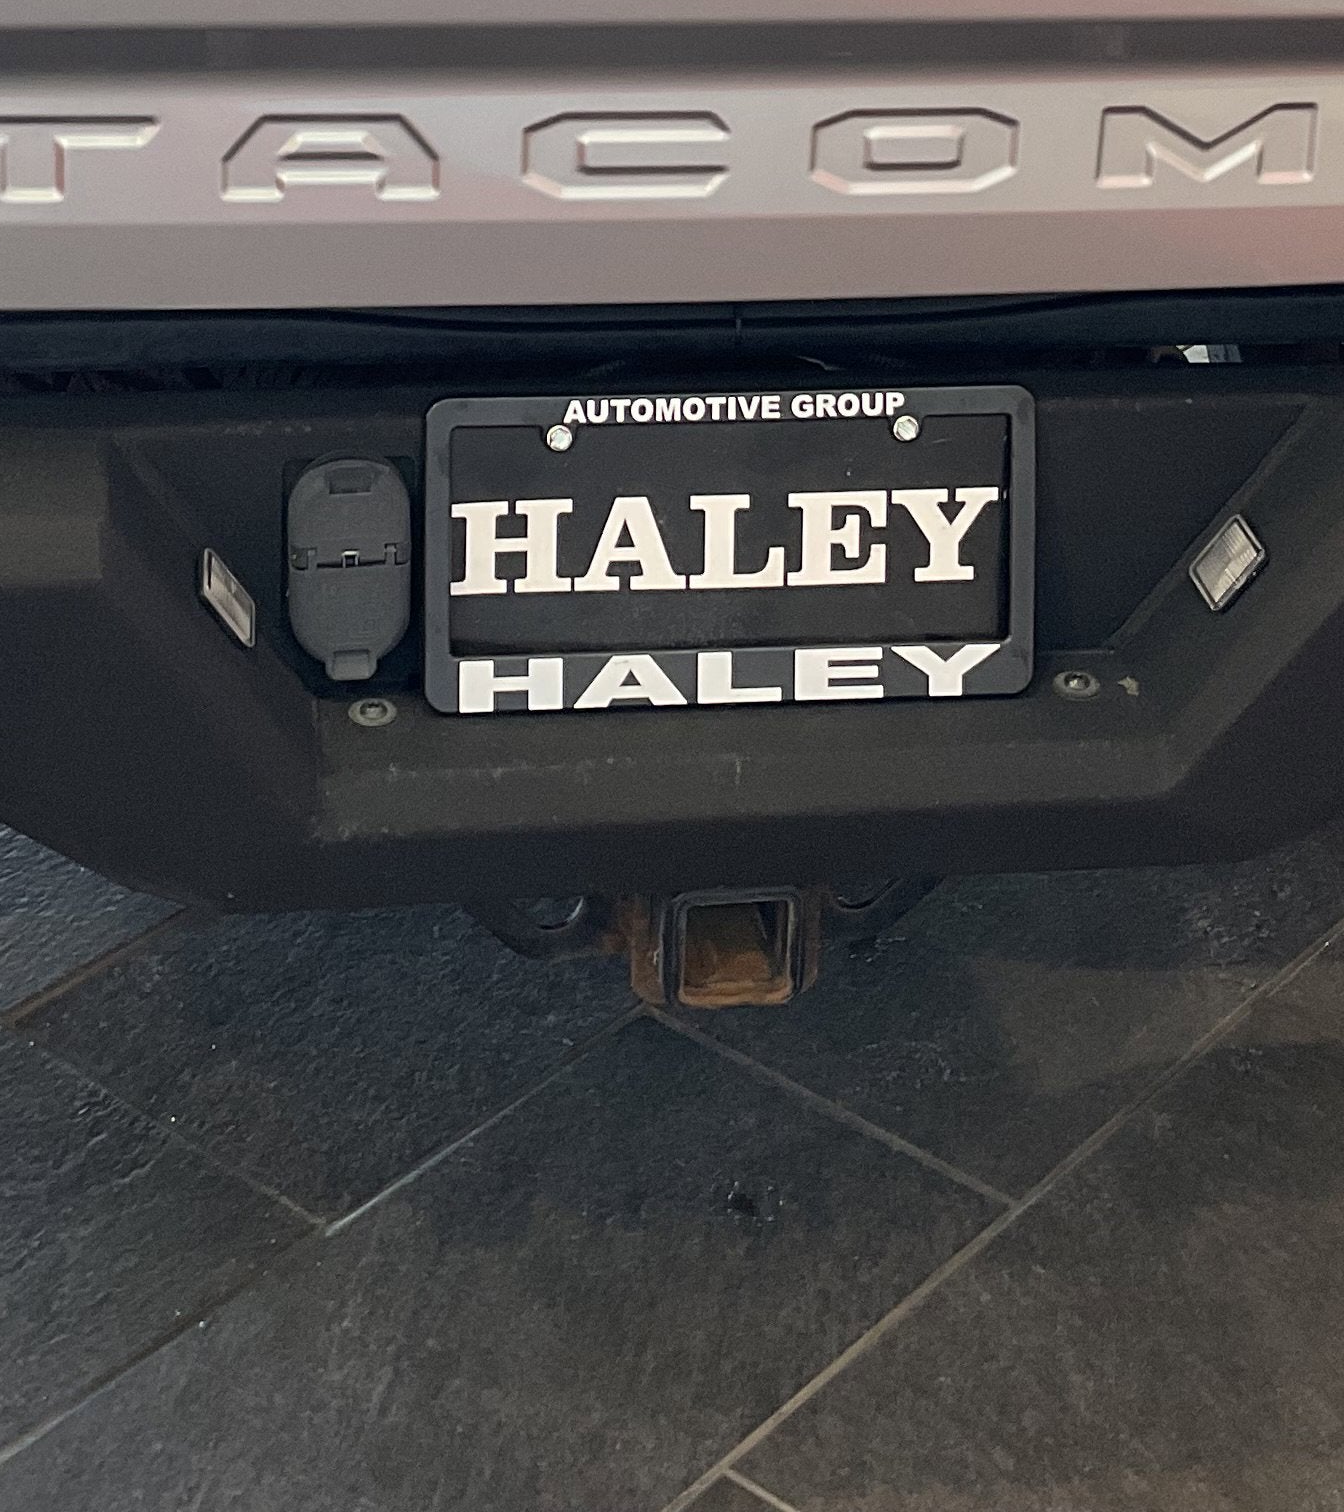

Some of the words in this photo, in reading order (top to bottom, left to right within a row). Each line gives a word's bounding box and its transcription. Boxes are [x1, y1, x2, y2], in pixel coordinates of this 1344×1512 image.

[563, 395, 782, 425] AUTOMOTIVE
[790, 391, 906, 418] GROUP
[449, 486, 1000, 596] HALEY
[458, 643, 1002, 714] HALEY
